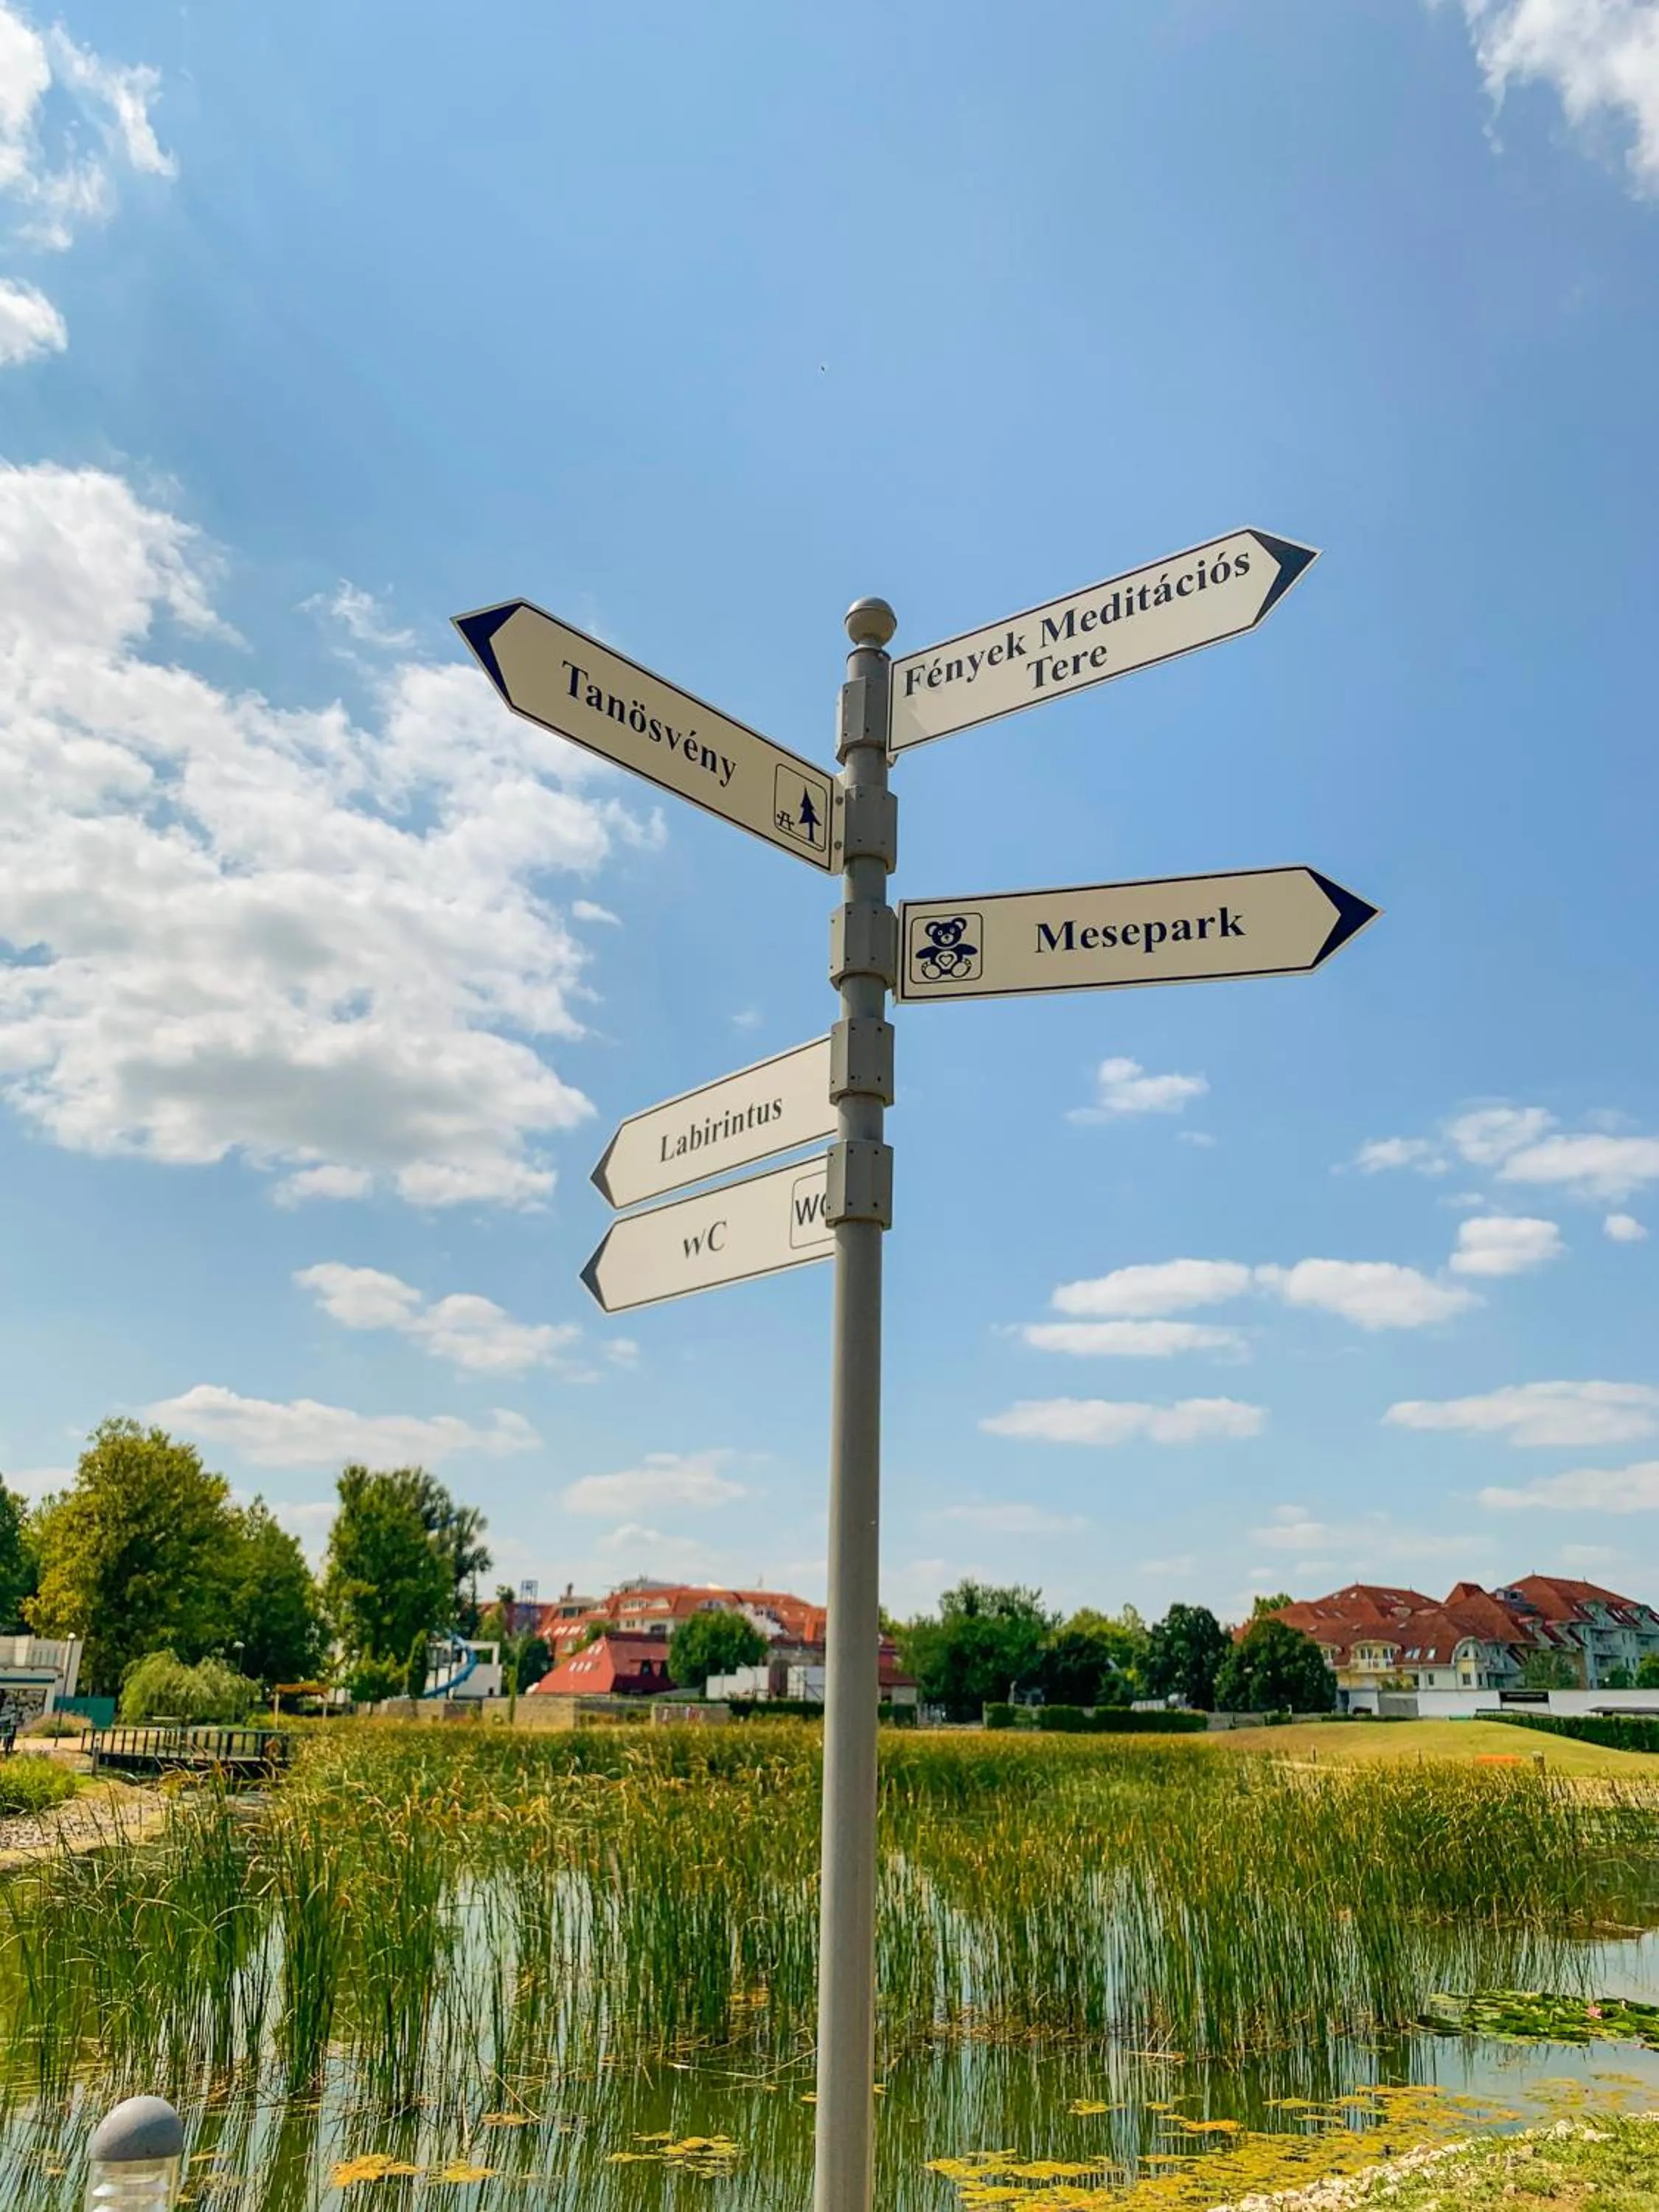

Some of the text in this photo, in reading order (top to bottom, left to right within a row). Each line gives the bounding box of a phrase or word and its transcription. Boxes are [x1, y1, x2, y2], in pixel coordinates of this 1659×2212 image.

[903, 552, 1251, 697] Fények Meditációs
[1027, 646, 1107, 689] Tere
[562, 660, 737, 787] Tanösvény
[1034, 907, 1246, 953] Mesepark
[661, 1098, 782, 1162] Labirintus
